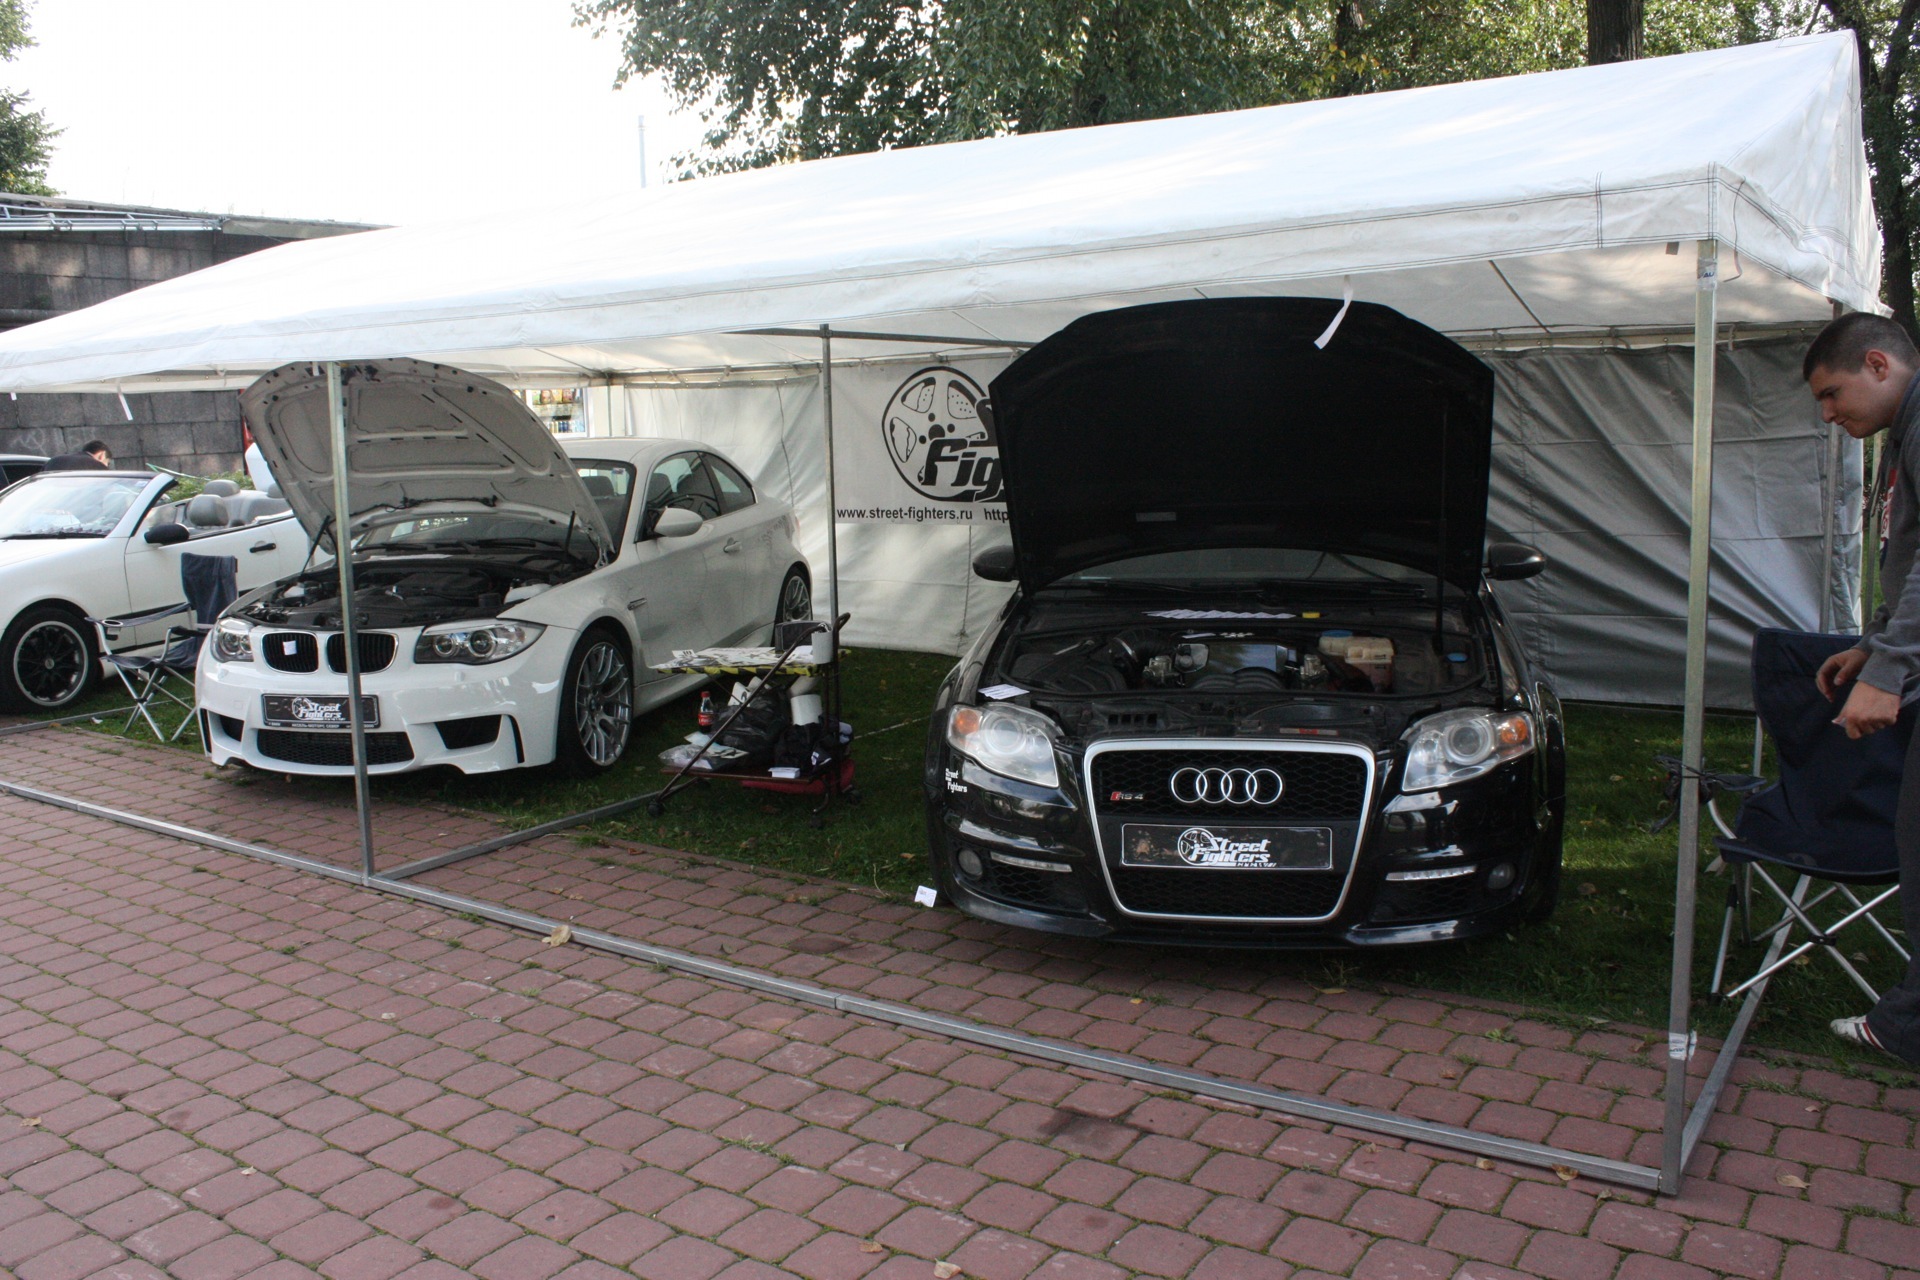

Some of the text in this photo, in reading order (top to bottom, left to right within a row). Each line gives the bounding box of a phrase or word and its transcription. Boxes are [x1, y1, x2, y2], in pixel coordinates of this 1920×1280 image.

[922, 438, 1003, 502] Fig
[837, 507, 973, 521] www.street-fighters.ru
[299, 708, 342, 719] Fighters
[306, 702, 341, 712] Street
[1208, 837, 1271, 852] Street
[1188, 848, 1271, 865] Fighters
